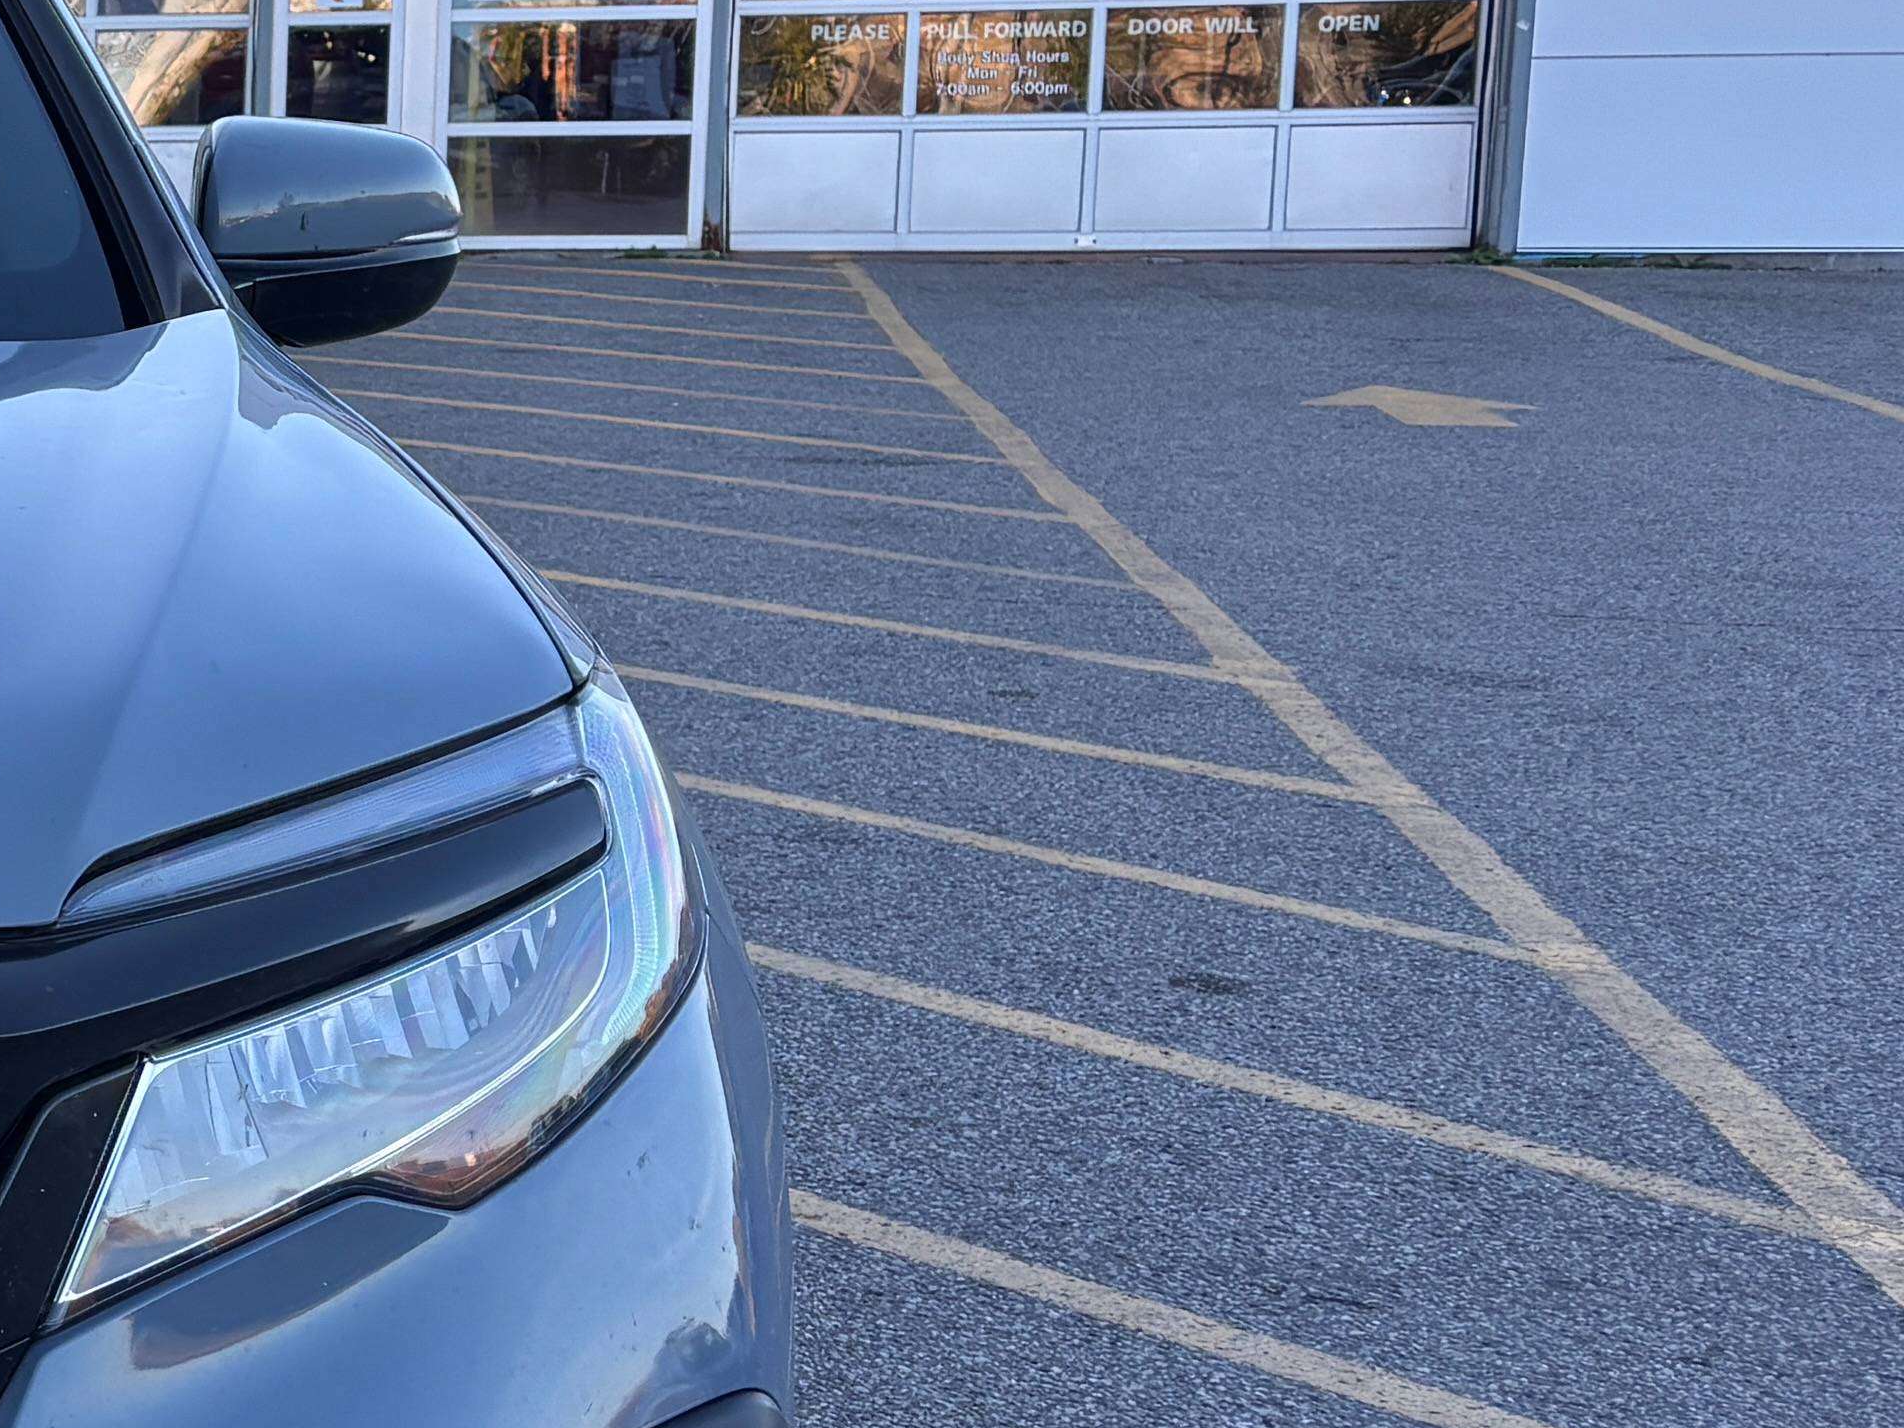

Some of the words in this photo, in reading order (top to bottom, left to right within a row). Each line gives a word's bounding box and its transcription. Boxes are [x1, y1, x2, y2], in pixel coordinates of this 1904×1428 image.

[811, 23, 890, 41] PLEASE
[926, 22, 976, 40] PULL
[983, 20, 1087, 39] FORWARD
[1127, 18, 1192, 35] DOOR
[1204, 16, 1258, 33] WILL
[1318, 14, 1380, 32] OPEN
[1026, 50, 1069, 63] Hours
[967, 67, 997, 79] Mon
[1018, 66, 1037, 79] Fri
[1010, 82, 1068, 96] 6:00pm
